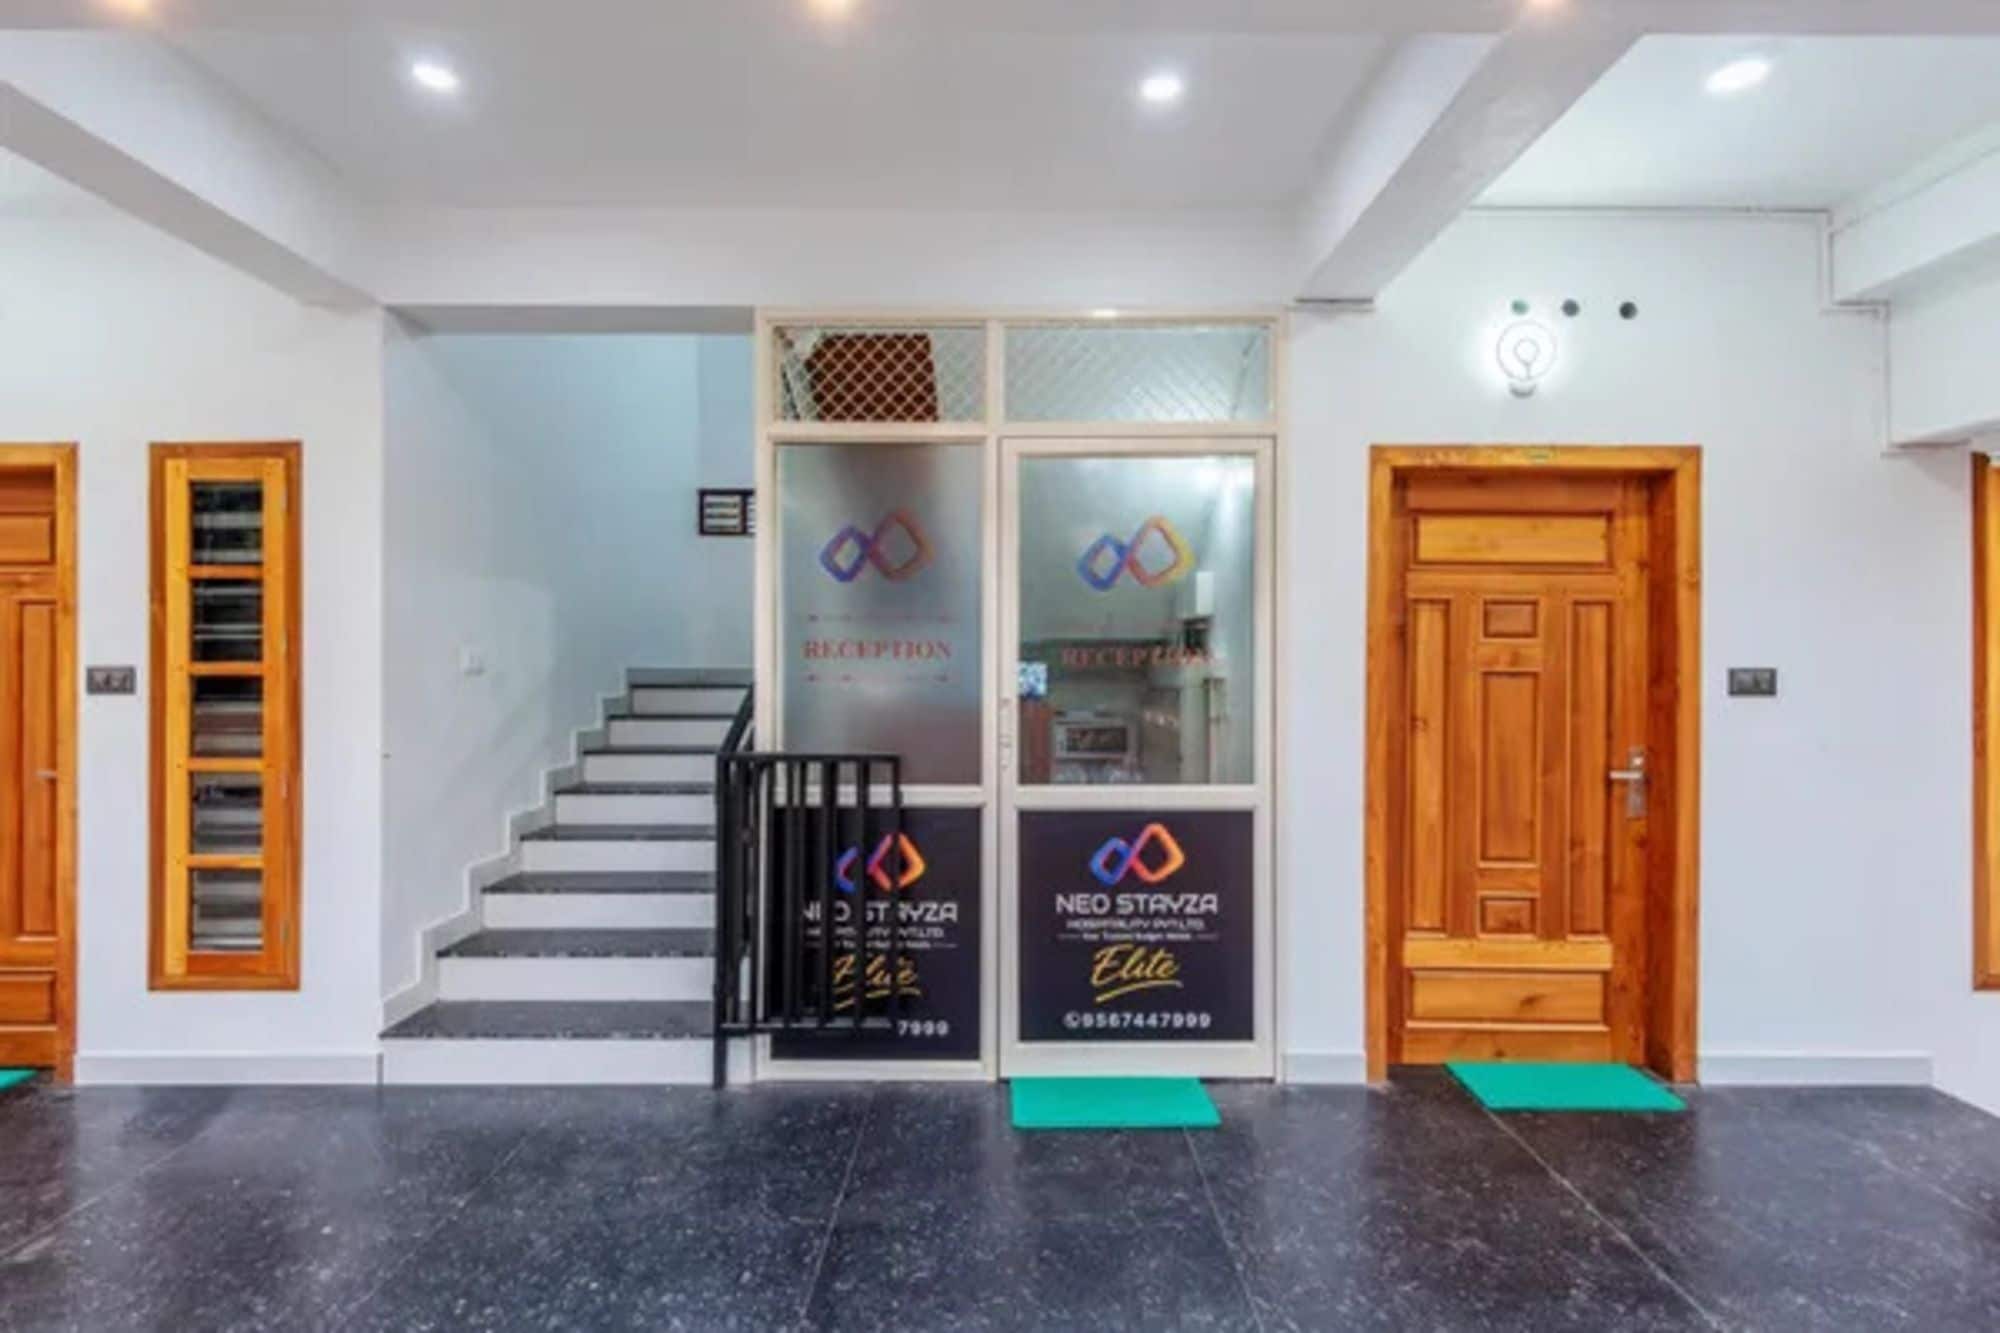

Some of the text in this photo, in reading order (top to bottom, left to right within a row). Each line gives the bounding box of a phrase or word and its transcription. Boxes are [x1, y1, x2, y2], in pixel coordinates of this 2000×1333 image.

[804, 639, 952, 660] RECEPTION
[1056, 893, 1218, 915] NEO STAYZA
[1091, 943, 1180, 987] Elite
